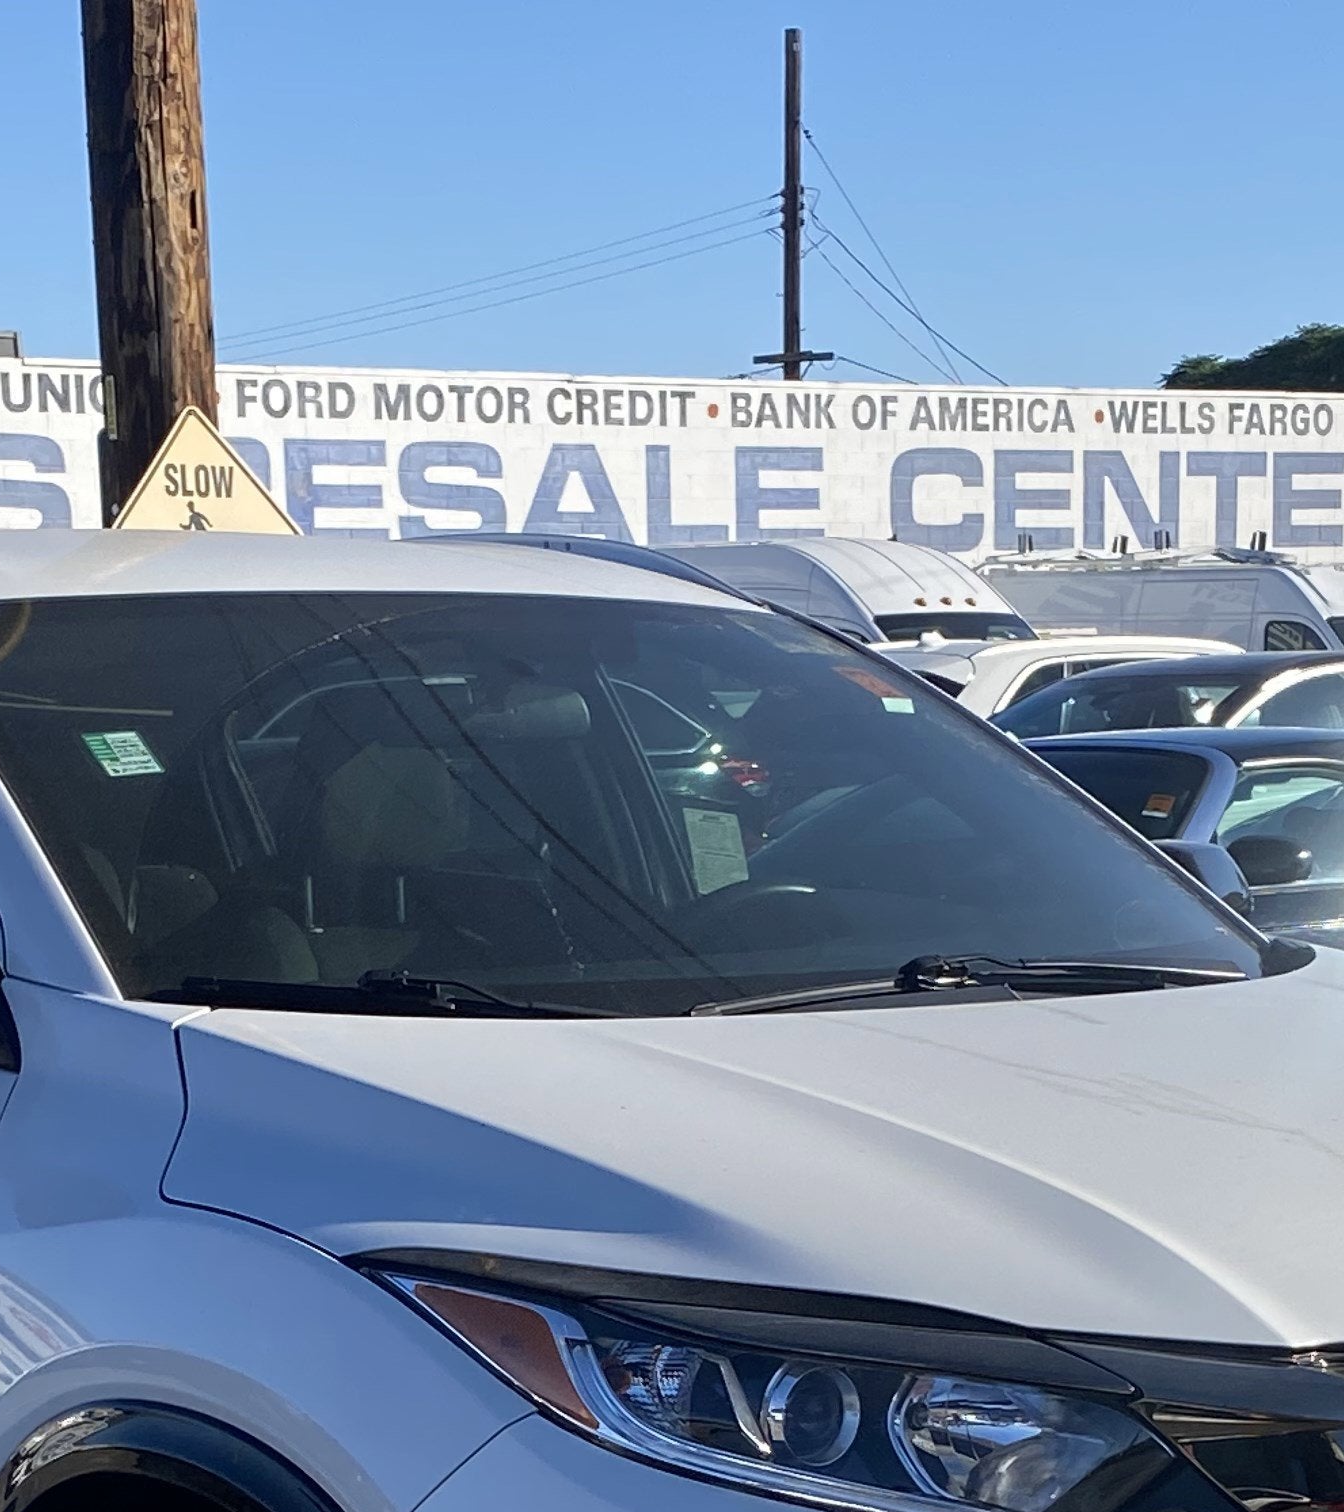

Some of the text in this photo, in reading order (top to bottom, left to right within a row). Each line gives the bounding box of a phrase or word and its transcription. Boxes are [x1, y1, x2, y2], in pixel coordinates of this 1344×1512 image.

[236, 379, 696, 427] FORD MOTOR CREDIT
[731, 392, 1075, 433] BANK OF AMERICA
[1108, 400, 1216, 434] WELLS
[1228, 403, 1334, 436] FARGO
[164, 463, 234, 498] SLOW
[224, 436, 825, 544] ESALE
